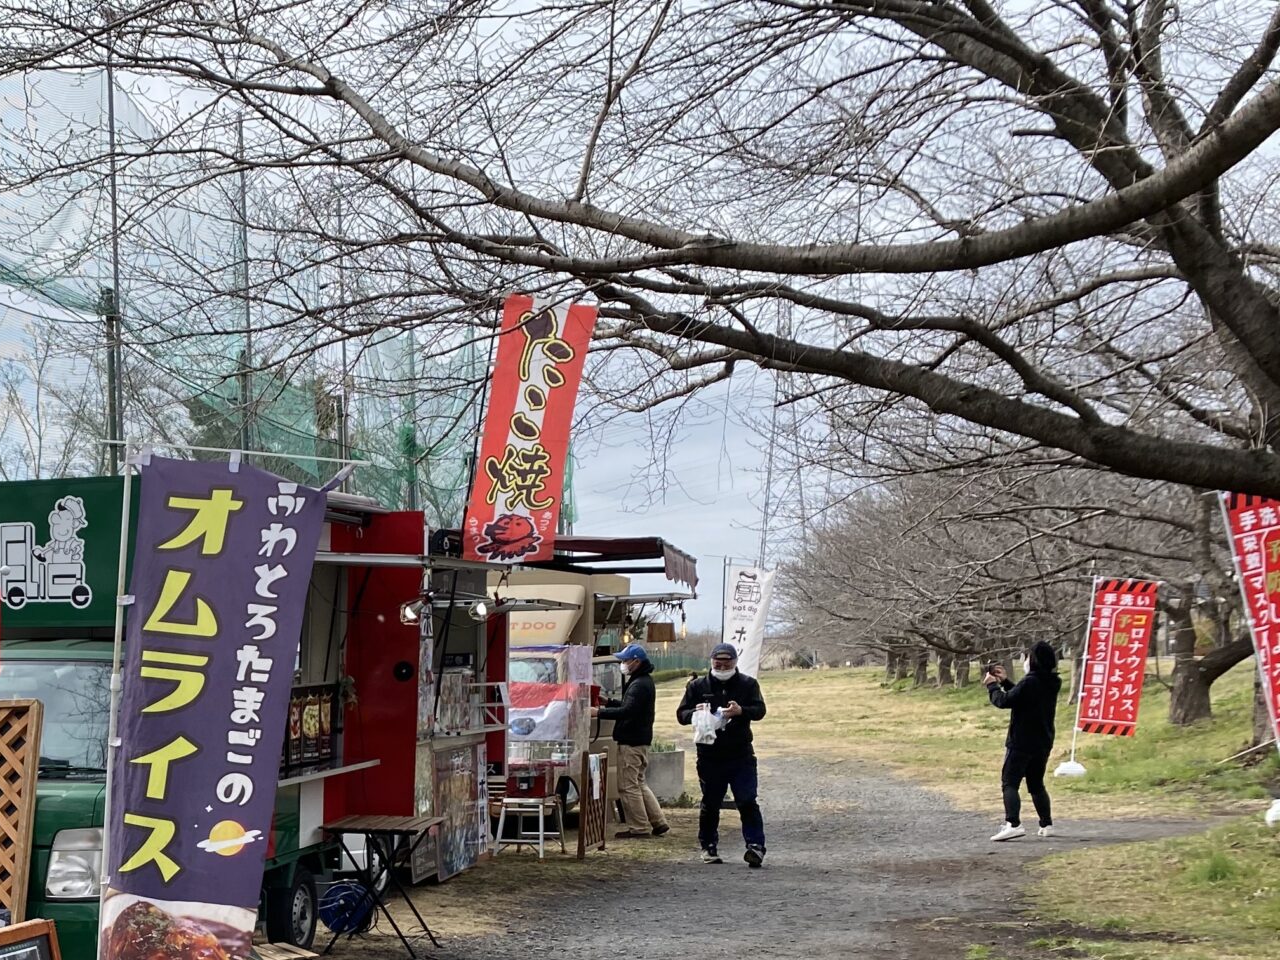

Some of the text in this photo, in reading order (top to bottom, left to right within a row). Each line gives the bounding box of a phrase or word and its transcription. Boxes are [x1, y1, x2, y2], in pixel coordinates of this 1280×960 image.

[1239, 508, 1280, 531] 手洗
[1103, 593, 1150, 606] 手洗い
[1250, 576, 1269, 624] マスク
[521, 621, 556, 631] DOG
[216, 482, 306, 806] ふわとろたまごの
[1095, 631, 1110, 660] マスク
[119, 489, 243, 883] オムライス
[1088, 688, 1100, 717] うがい
